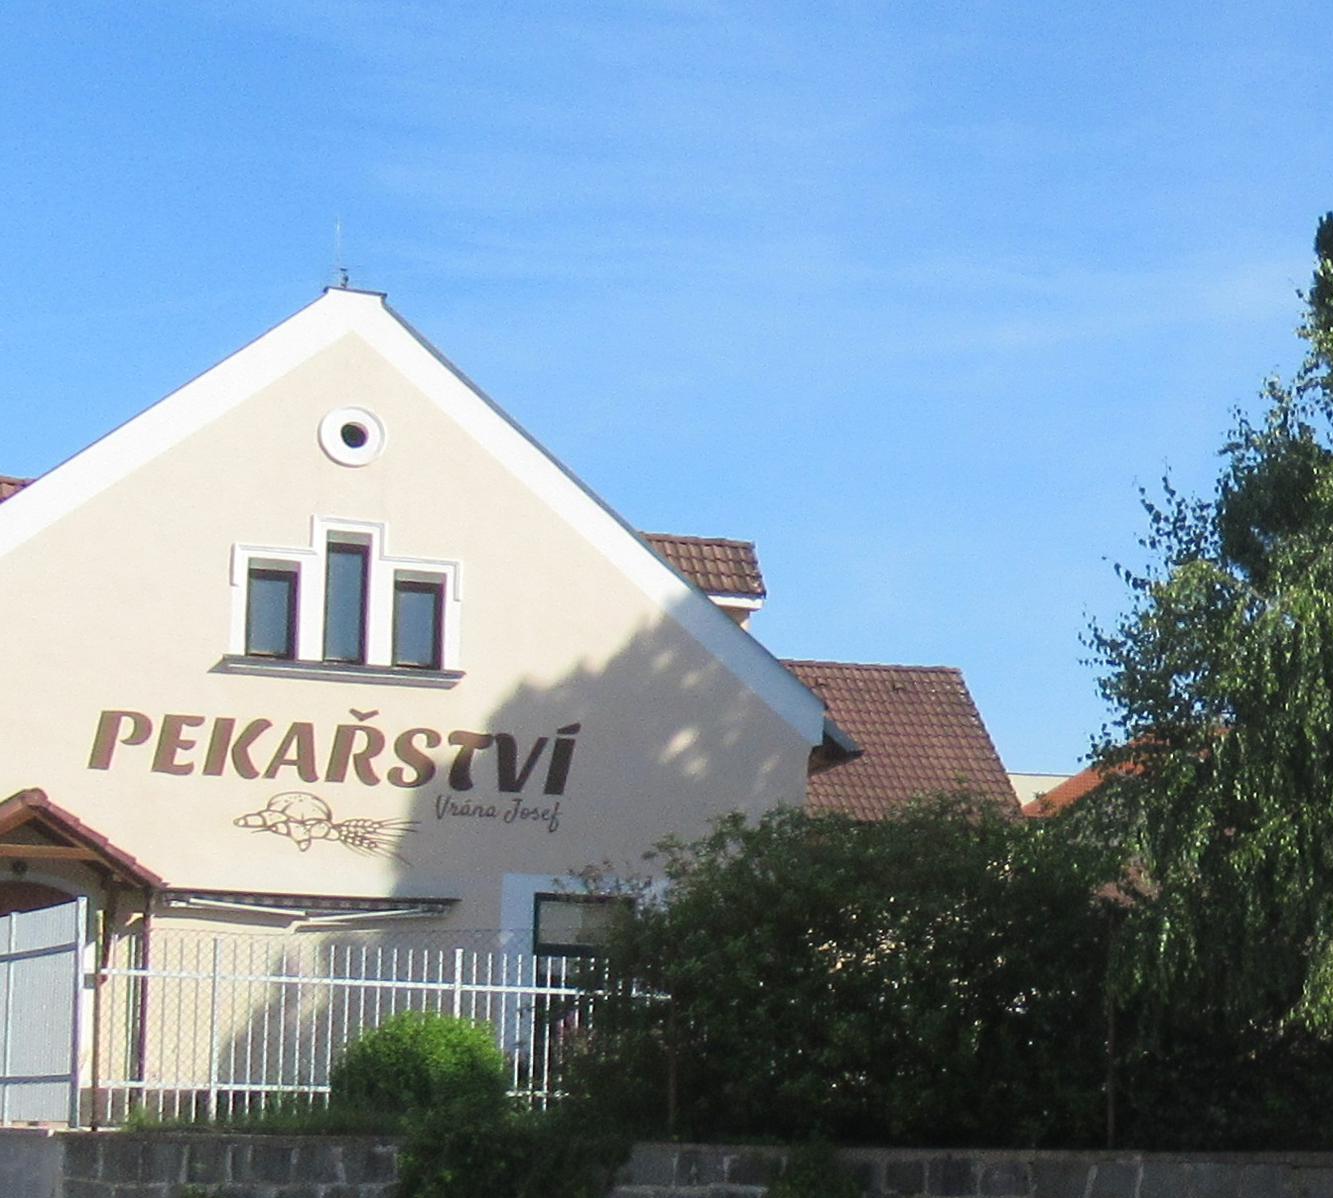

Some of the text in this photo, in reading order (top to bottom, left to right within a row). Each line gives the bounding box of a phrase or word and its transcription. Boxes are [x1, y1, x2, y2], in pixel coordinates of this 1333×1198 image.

[88, 708, 581, 795] PEKAŘSTVÍ
[436, 795, 562, 832] Vrána Josef
